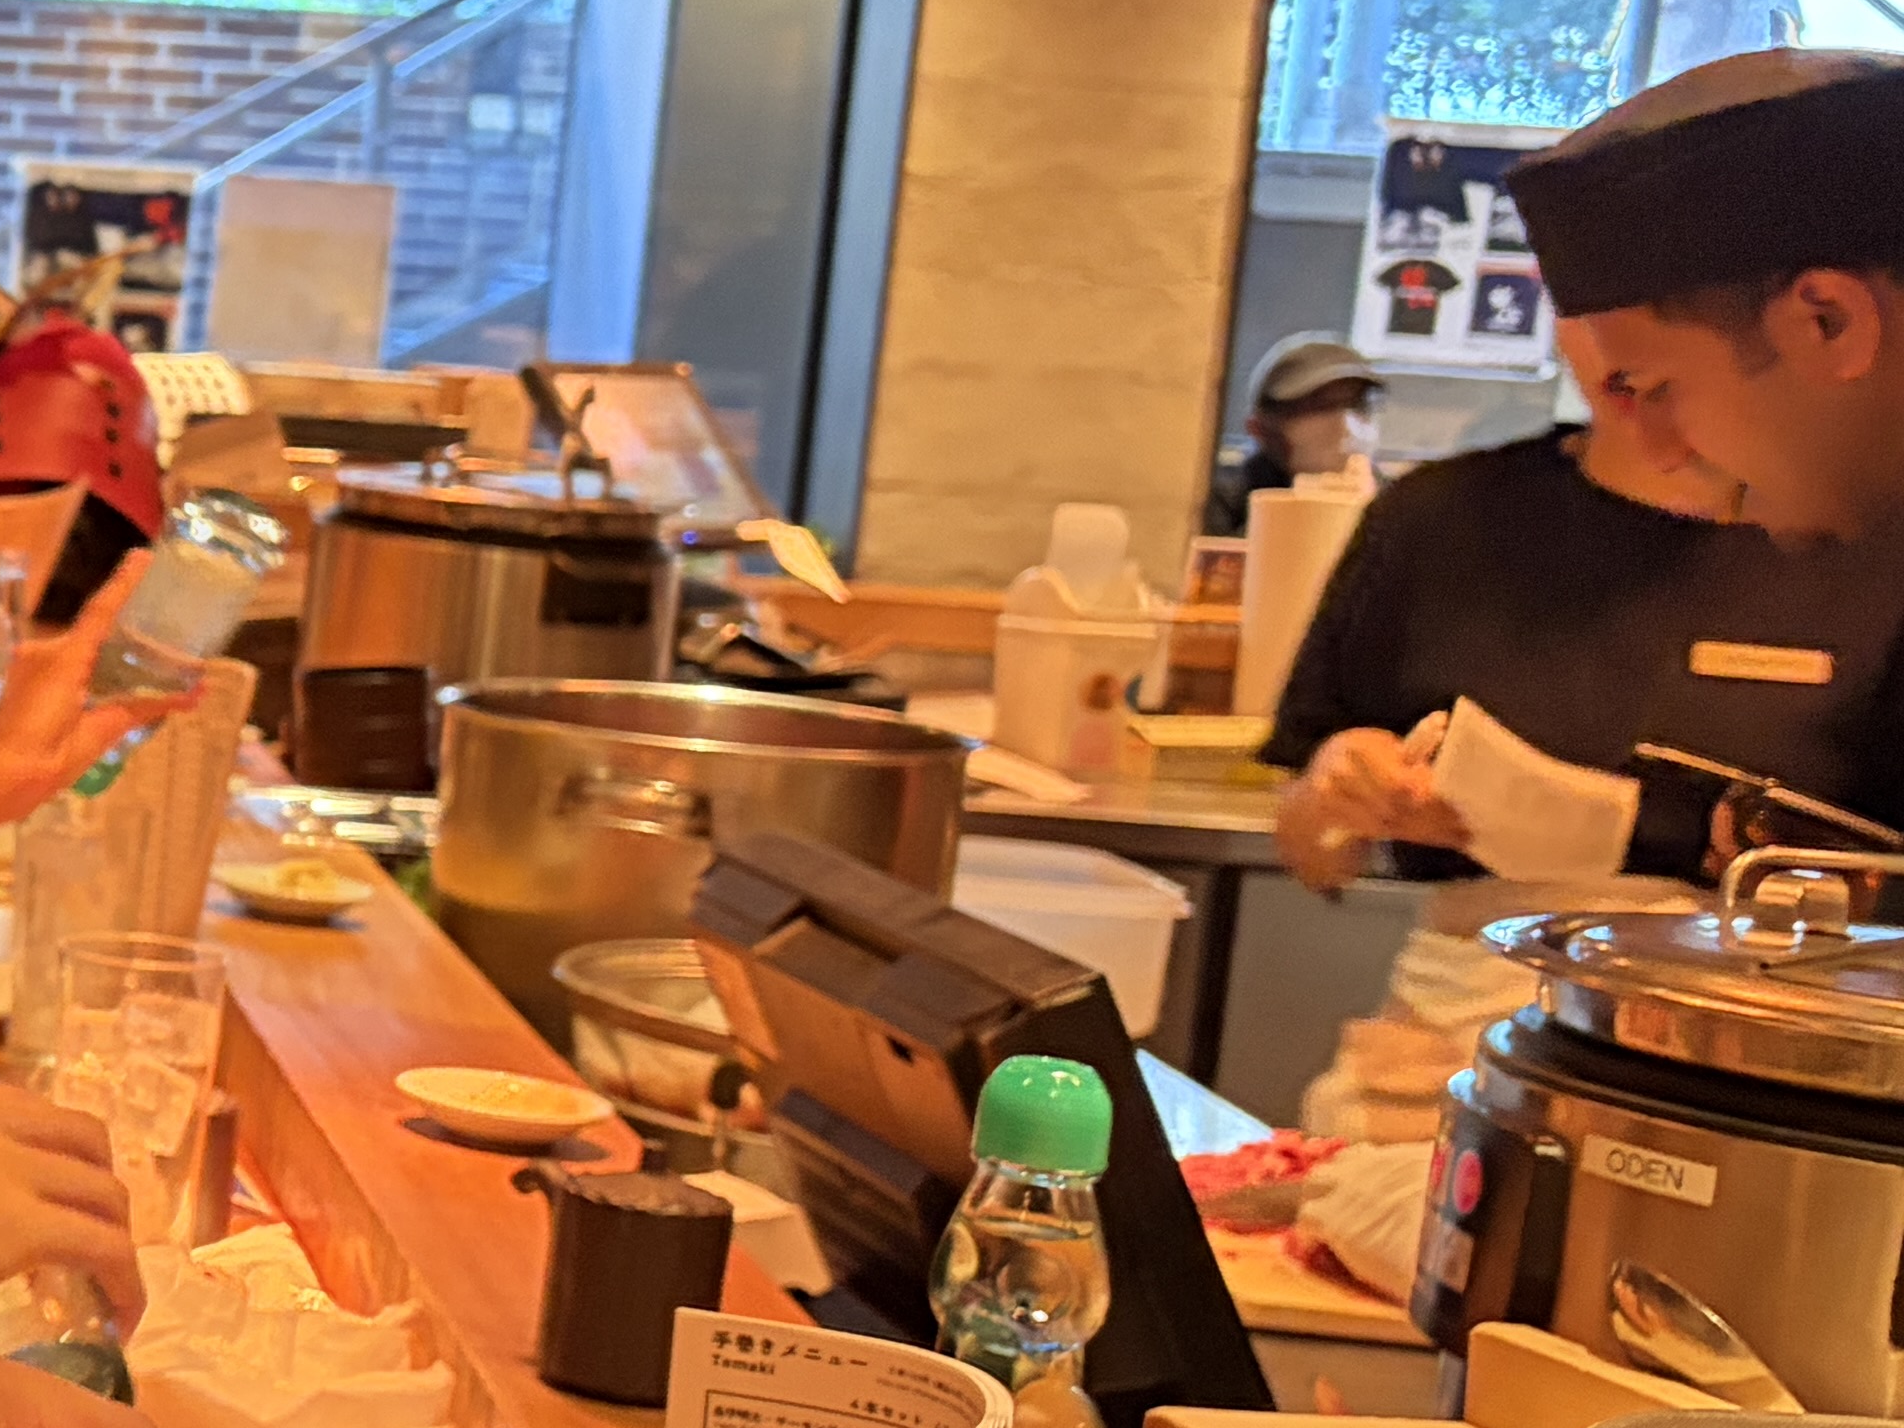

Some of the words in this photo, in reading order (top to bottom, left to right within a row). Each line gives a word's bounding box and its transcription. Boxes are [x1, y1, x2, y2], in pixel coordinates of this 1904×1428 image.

[1607, 1148, 1684, 1190] ODEN
[712, 1330, 868, 1367] 手巻きメニュー
